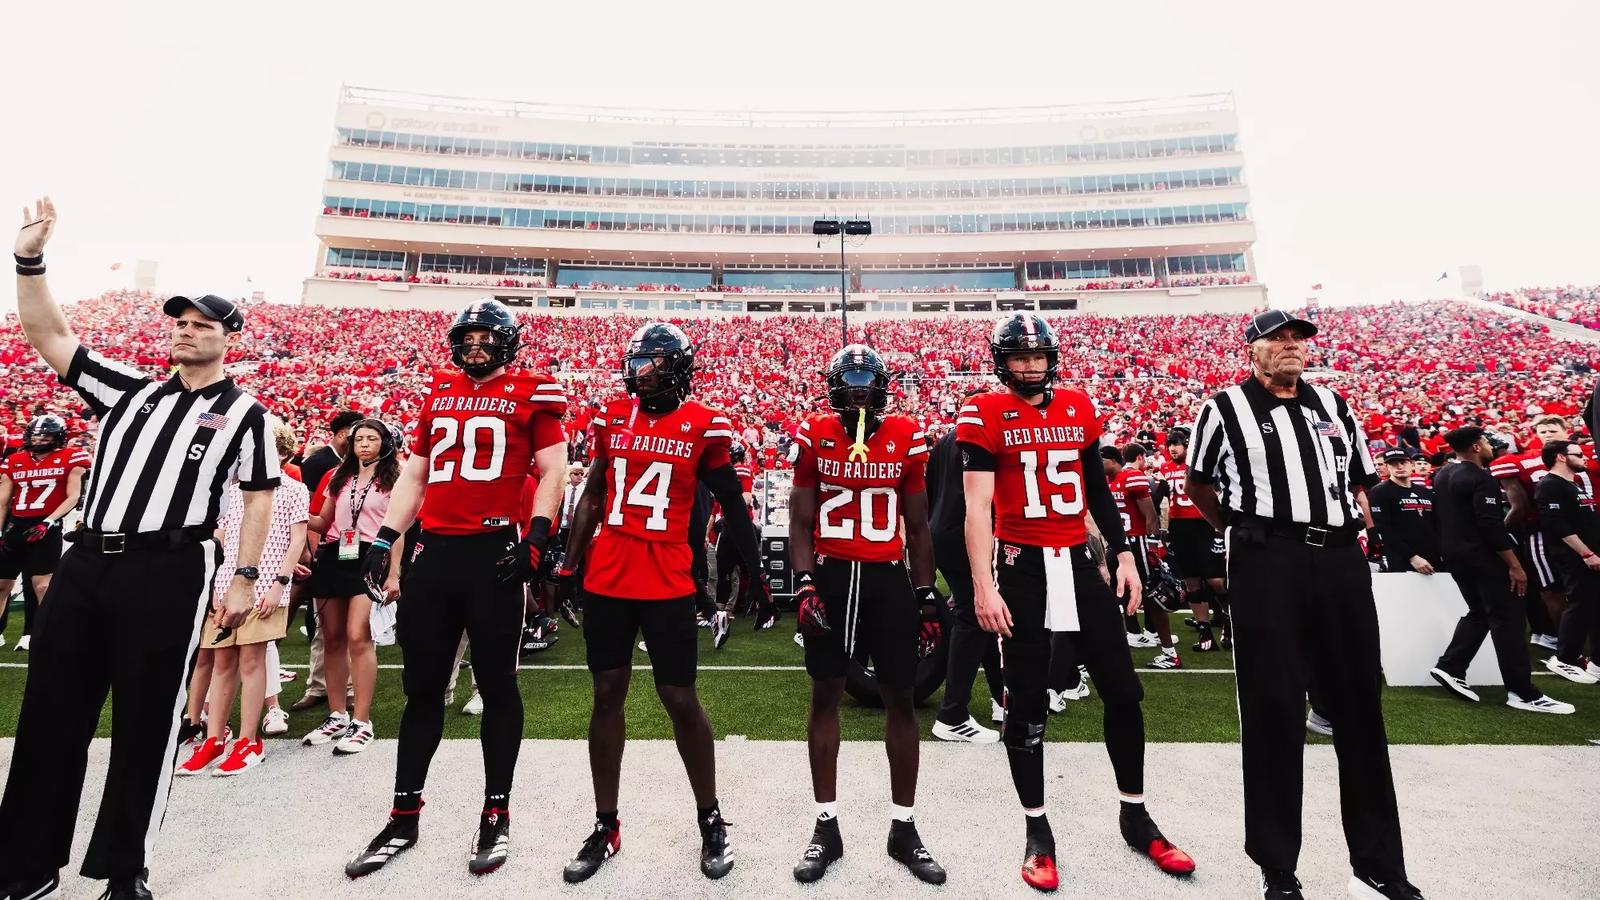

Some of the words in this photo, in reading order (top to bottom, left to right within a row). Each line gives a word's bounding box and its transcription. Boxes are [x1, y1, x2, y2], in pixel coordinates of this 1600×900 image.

[431, 396, 455, 412] RED
[455, 396, 517, 414] RAIDERS
[632, 435, 694, 458] RAIDERS
[1003, 428, 1032, 446] RED
[1033, 426, 1085, 443] RAIDERS
[188, 443, 206, 460] S
[428, 415, 507, 484] 20
[12, 470, 26, 480] RED
[27, 467, 65, 478] RAIDERS
[817, 457, 840, 477] RED
[844, 462, 903, 478] RAIDERS
[1335, 455, 1347, 472] H
[15, 479, 57, 510] 17
[607, 456, 673, 531] 14
[1020, 449, 1084, 518] 15
[820, 481, 898, 542] 20
